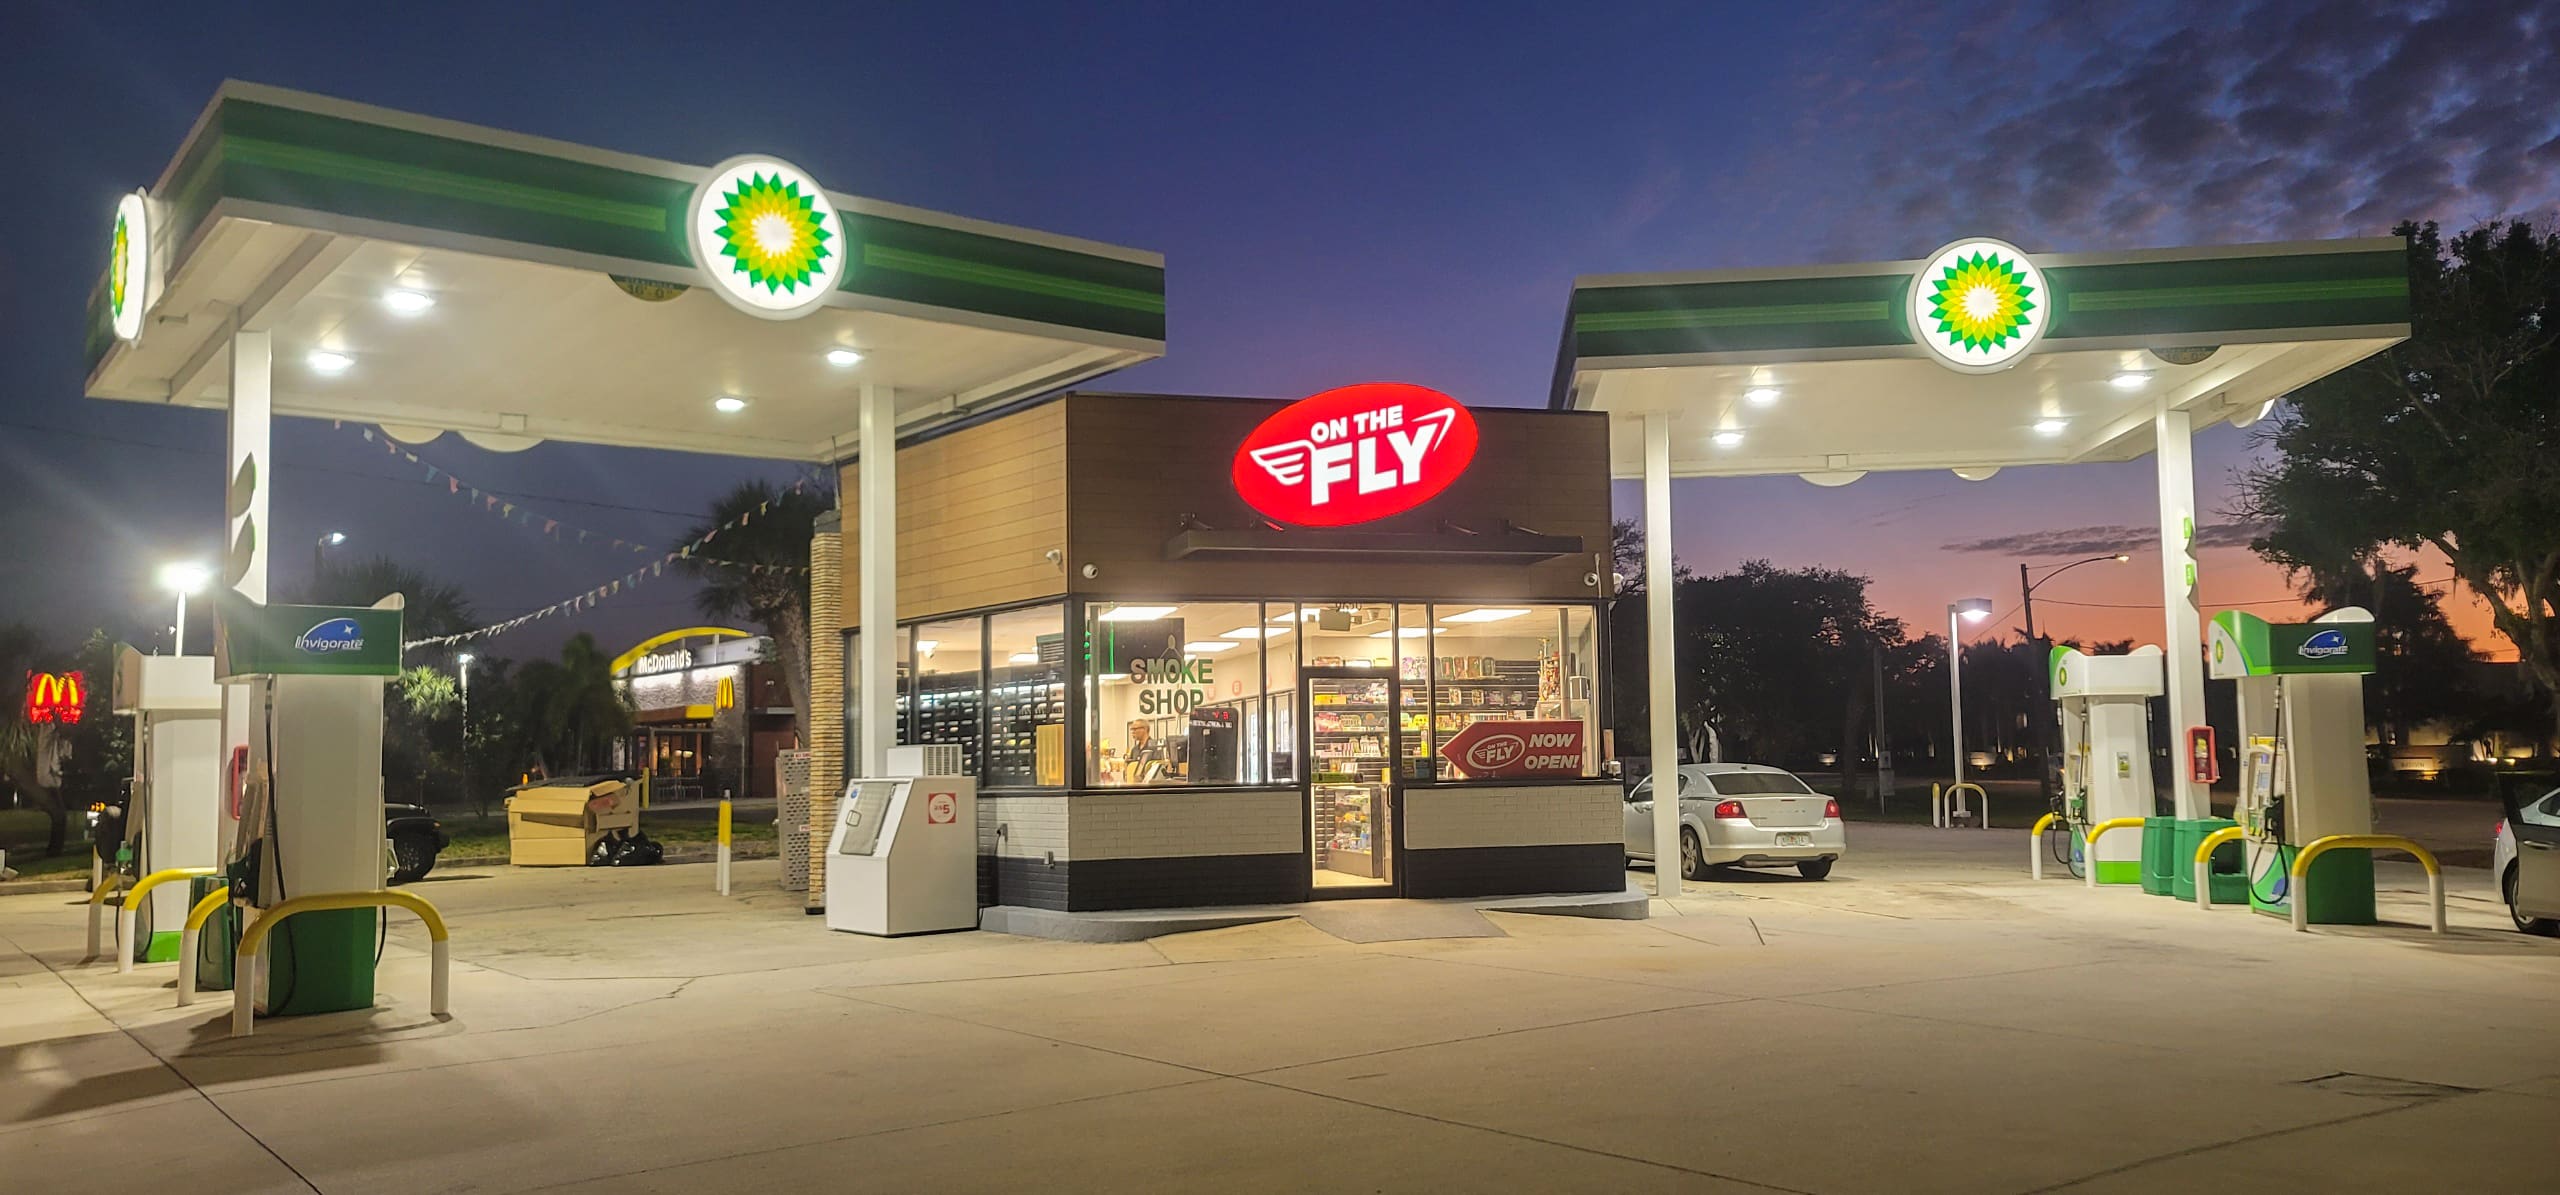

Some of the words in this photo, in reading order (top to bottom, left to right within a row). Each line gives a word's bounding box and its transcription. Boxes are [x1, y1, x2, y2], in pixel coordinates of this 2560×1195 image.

[1310, 416, 1348, 443] ON
[1353, 404, 1404, 435] THE
[1310, 422, 1439, 507] FLY
[294, 635, 364, 651] Invigorate
[639, 648, 692, 674] McDonald's
[1130, 658, 1214, 684] SMOKE
[1139, 689, 1204, 715] SHOP
[1528, 733, 1577, 748] NOW
[1486, 745, 1514, 764] FLY
[1524, 754, 1580, 769] OPEN!
